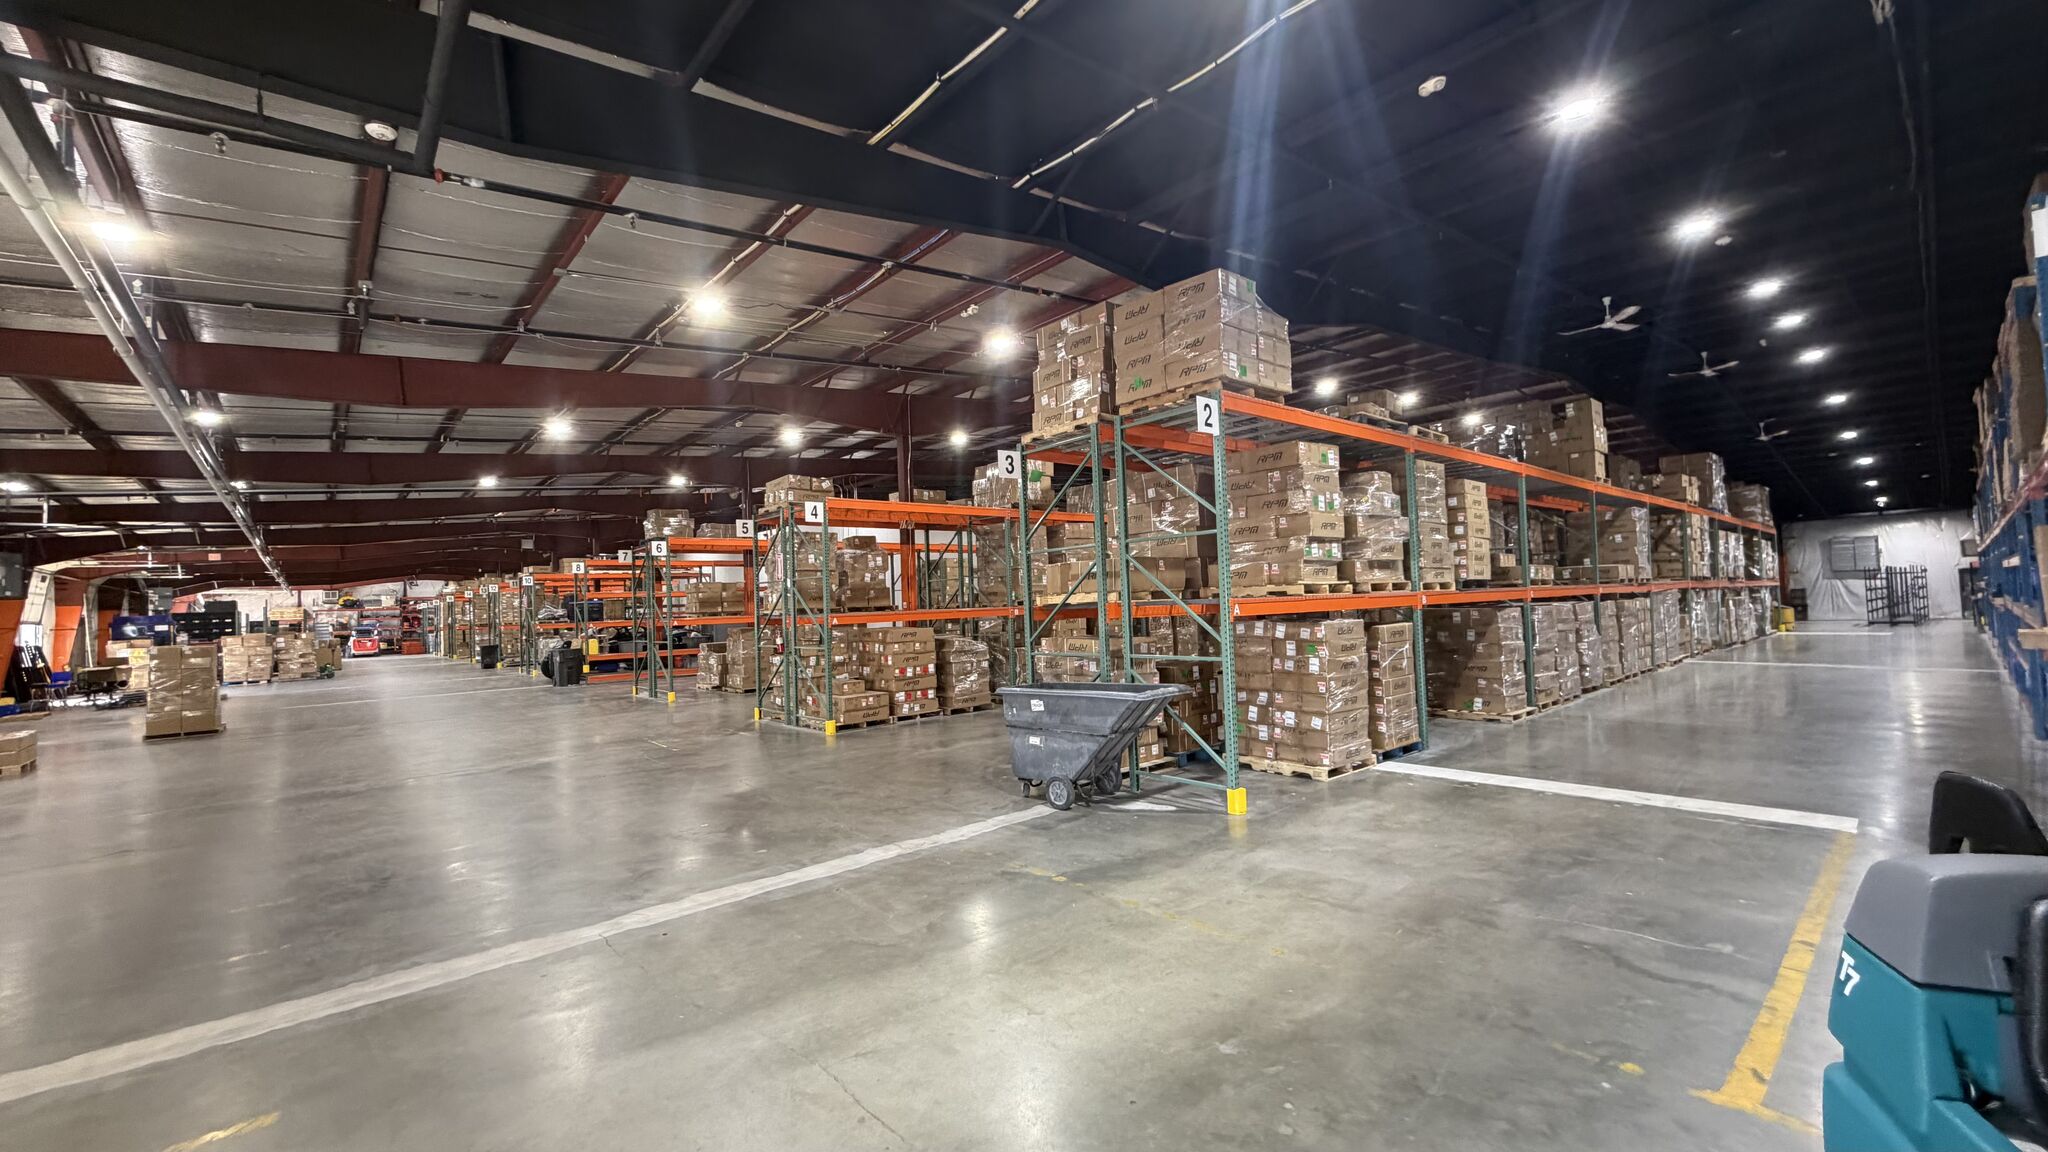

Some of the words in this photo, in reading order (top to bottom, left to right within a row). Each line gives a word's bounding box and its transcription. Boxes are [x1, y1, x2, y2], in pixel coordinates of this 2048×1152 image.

[1178, 282, 1205, 299] RPM
[1127, 354, 1151, 370] RPM
[1179, 363, 1207, 378] RPM
[1203, 403, 1213, 428] 2
[1257, 451, 1283, 465] RPM
[1005, 454, 1015, 475] 3
[1313, 474, 1330, 483] RPM
[1261, 498, 1288, 510] RPM
[810, 505, 819, 519] 4
[742, 523, 749, 534] 5
[1234, 525, 1259, 536] RPM
[1320, 522, 1337, 531] RPM
[656, 543, 663, 553] 6
[622, 552, 628, 561] 7
[575, 564, 581, 572] 8
[1312, 567, 1328, 576] RPM
[1233, 603, 1240, 616] A
[832, 617, 839, 625] A
[1839, 950, 1861, 997] T7
